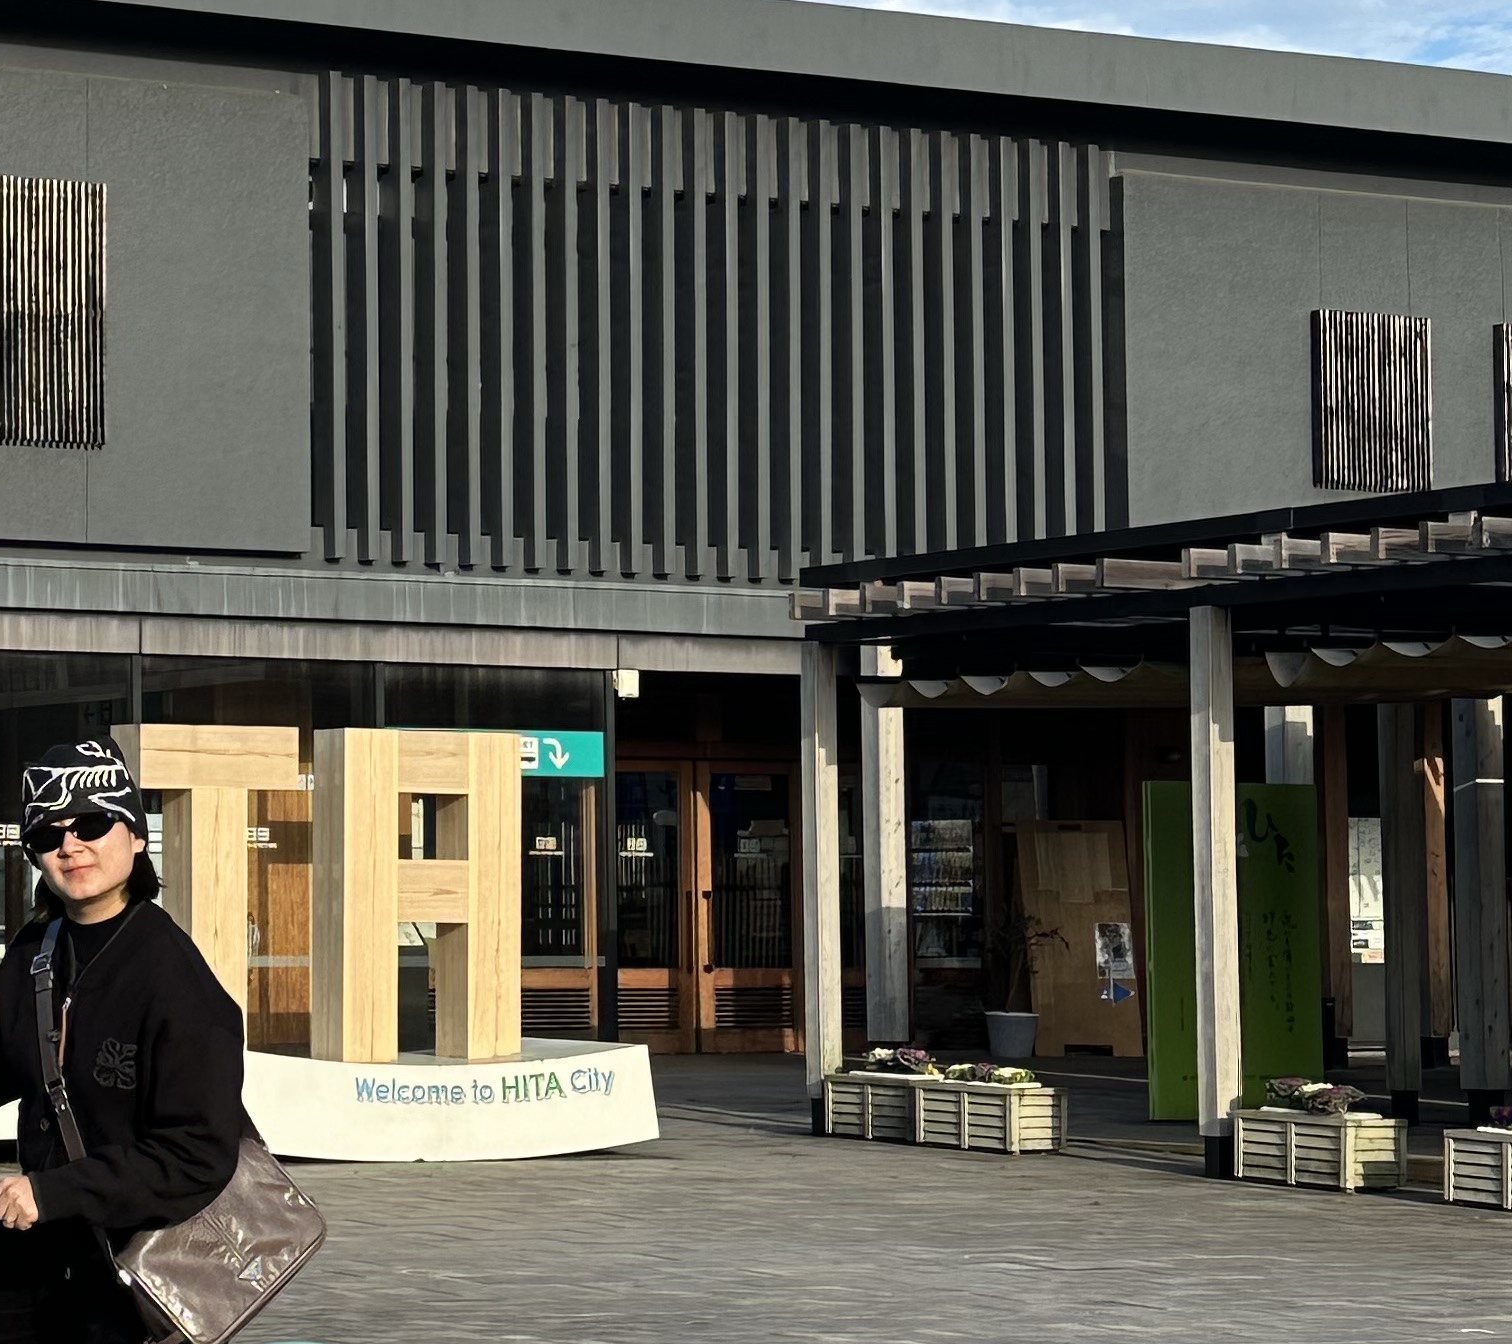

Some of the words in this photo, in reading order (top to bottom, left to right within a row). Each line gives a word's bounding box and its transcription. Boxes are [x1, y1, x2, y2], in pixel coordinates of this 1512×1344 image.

[355, 1077, 465, 1104] Welcome
[472, 1079, 494, 1104] to
[501, 1071, 566, 1103] HITA
[570, 1067, 615, 1095] City
